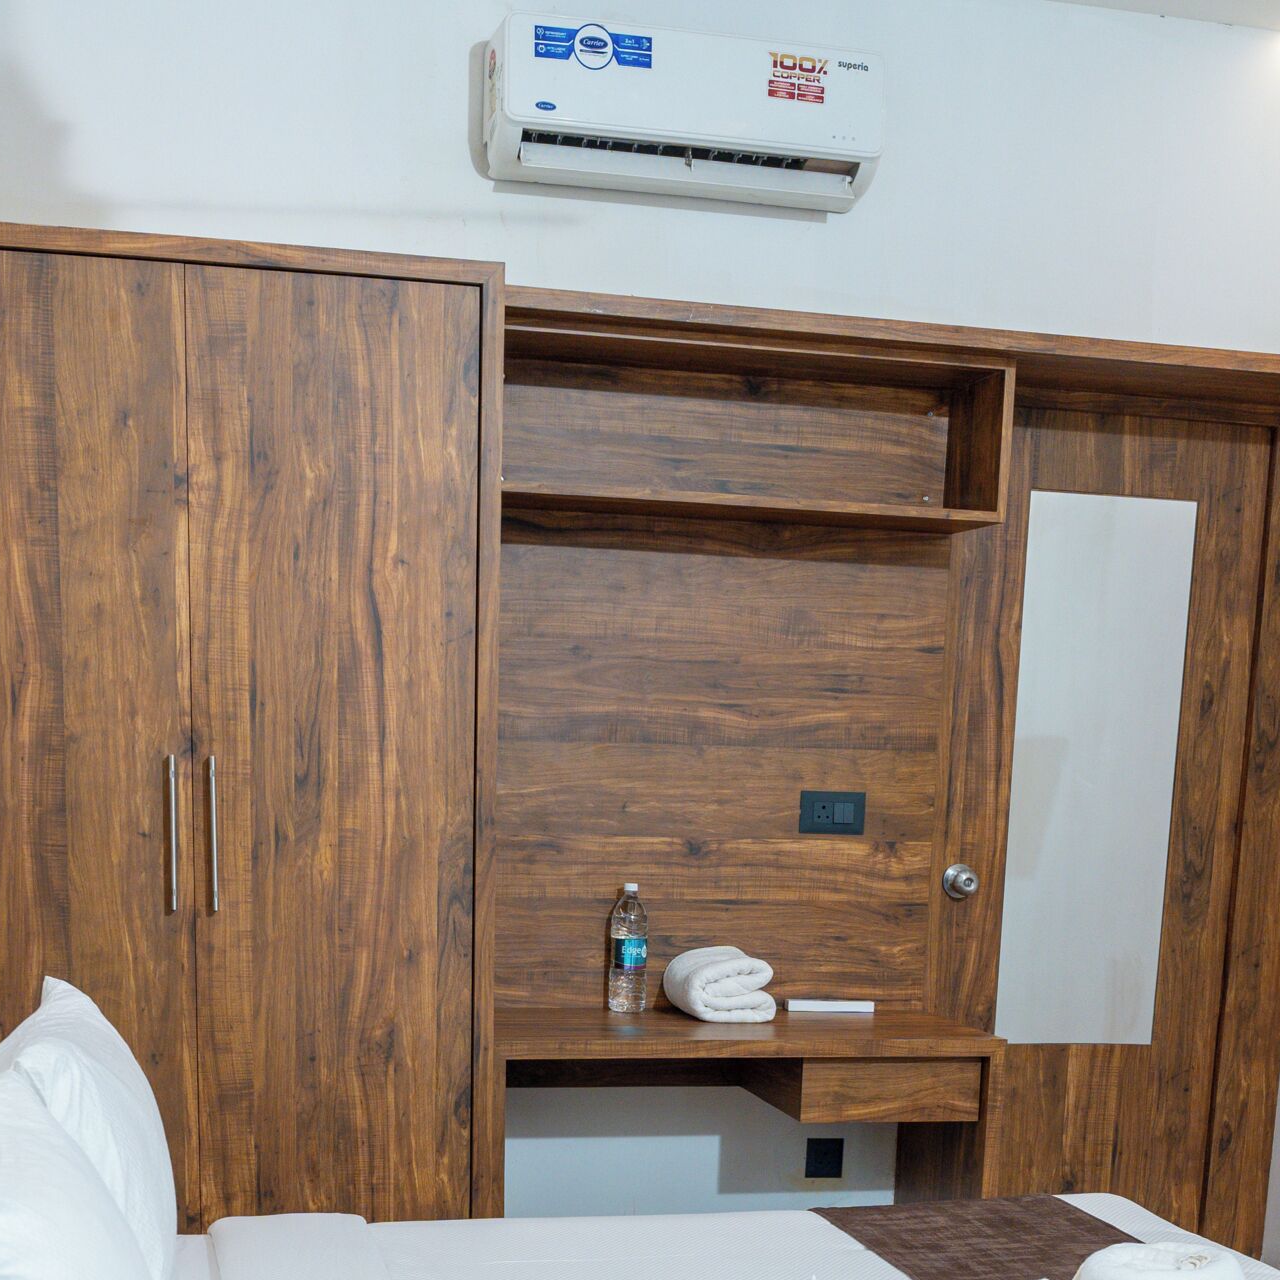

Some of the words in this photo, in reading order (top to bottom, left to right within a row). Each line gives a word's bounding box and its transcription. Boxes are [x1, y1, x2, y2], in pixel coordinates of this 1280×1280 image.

[582, 38, 604, 47] Carrier
[768, 52, 829, 75] 100%
[838, 61, 869, 72] superia
[772, 70, 822, 83] COPPER
[621, 946, 641, 955] Edge
